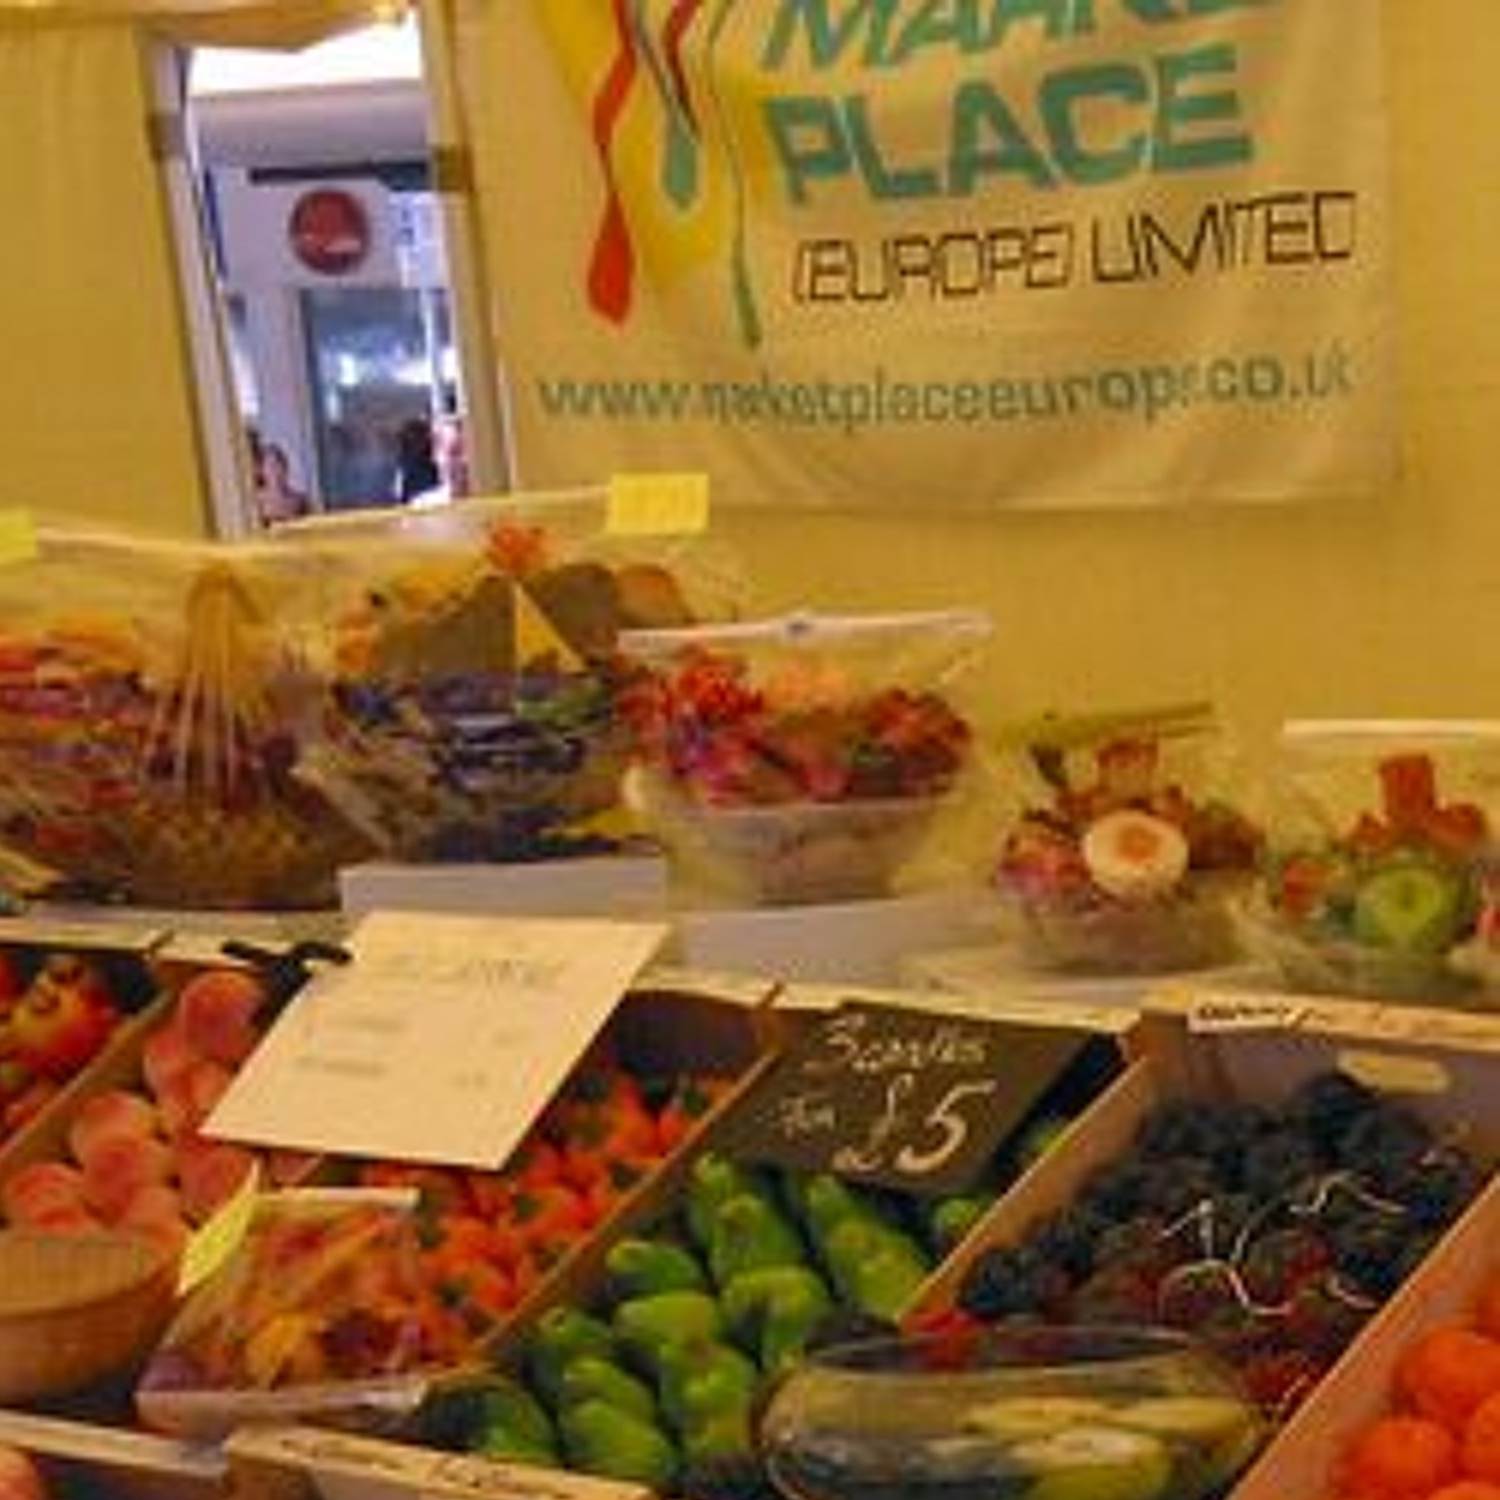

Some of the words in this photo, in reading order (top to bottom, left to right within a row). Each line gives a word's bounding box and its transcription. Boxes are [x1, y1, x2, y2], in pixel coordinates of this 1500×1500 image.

[764, 44, 1255, 204] PLACE
[794, 221, 1074, 301] (EUROPE)
[1091, 190, 1357, 283] LIMITED
[833, 1073, 997, 1172] £5
